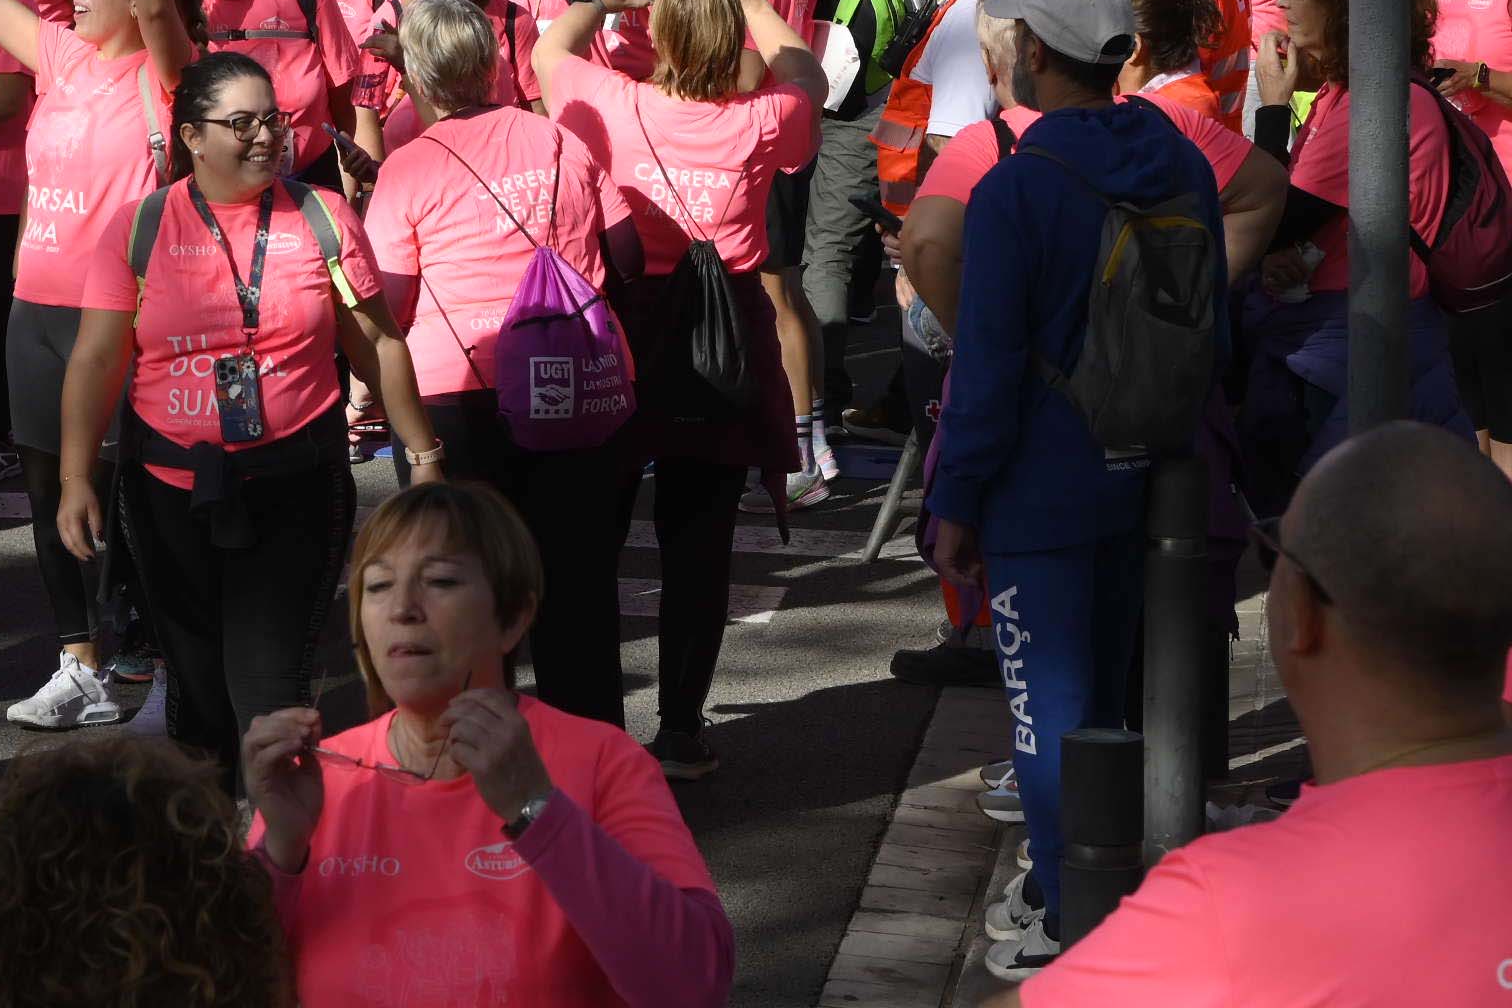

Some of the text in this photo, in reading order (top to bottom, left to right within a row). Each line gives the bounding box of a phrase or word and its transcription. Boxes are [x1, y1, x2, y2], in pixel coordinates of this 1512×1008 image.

[477, 168, 557, 201] CARRERA
[634, 163, 730, 189] CARRERA
[496, 187, 554, 215] DE LA
[687, 187, 712, 205] LA
[540, 363, 571, 379] UGT
[582, 394, 628, 416] FORÇA
[991, 585, 1038, 756] BARÇA
[319, 854, 400, 878] OYSHO
